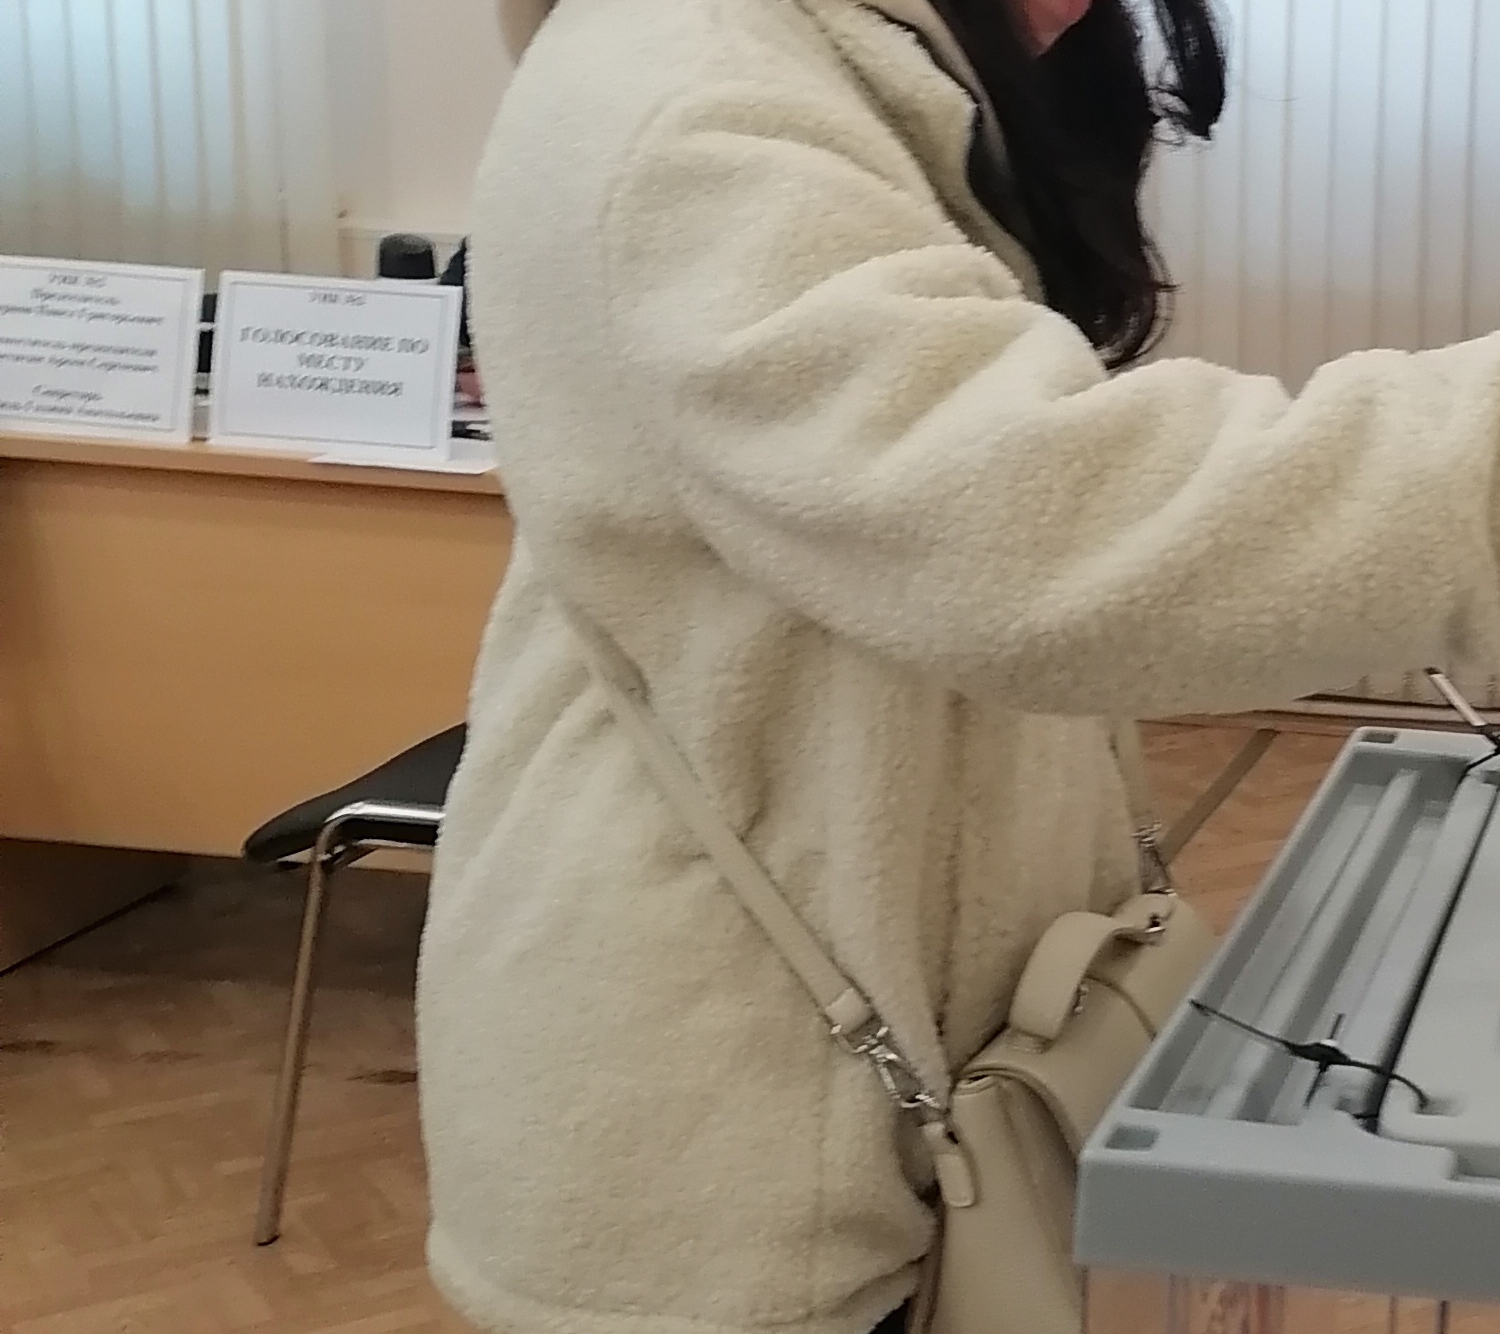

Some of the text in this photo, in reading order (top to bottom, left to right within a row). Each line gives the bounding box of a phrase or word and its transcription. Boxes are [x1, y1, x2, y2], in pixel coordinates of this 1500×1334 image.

[239, 325, 430, 355] ГОЛОСОВАНИЕ ПО
[296, 352, 369, 372] МЕСТУ
[256, 371, 404, 398] НАХОЖДЕНИЯ
